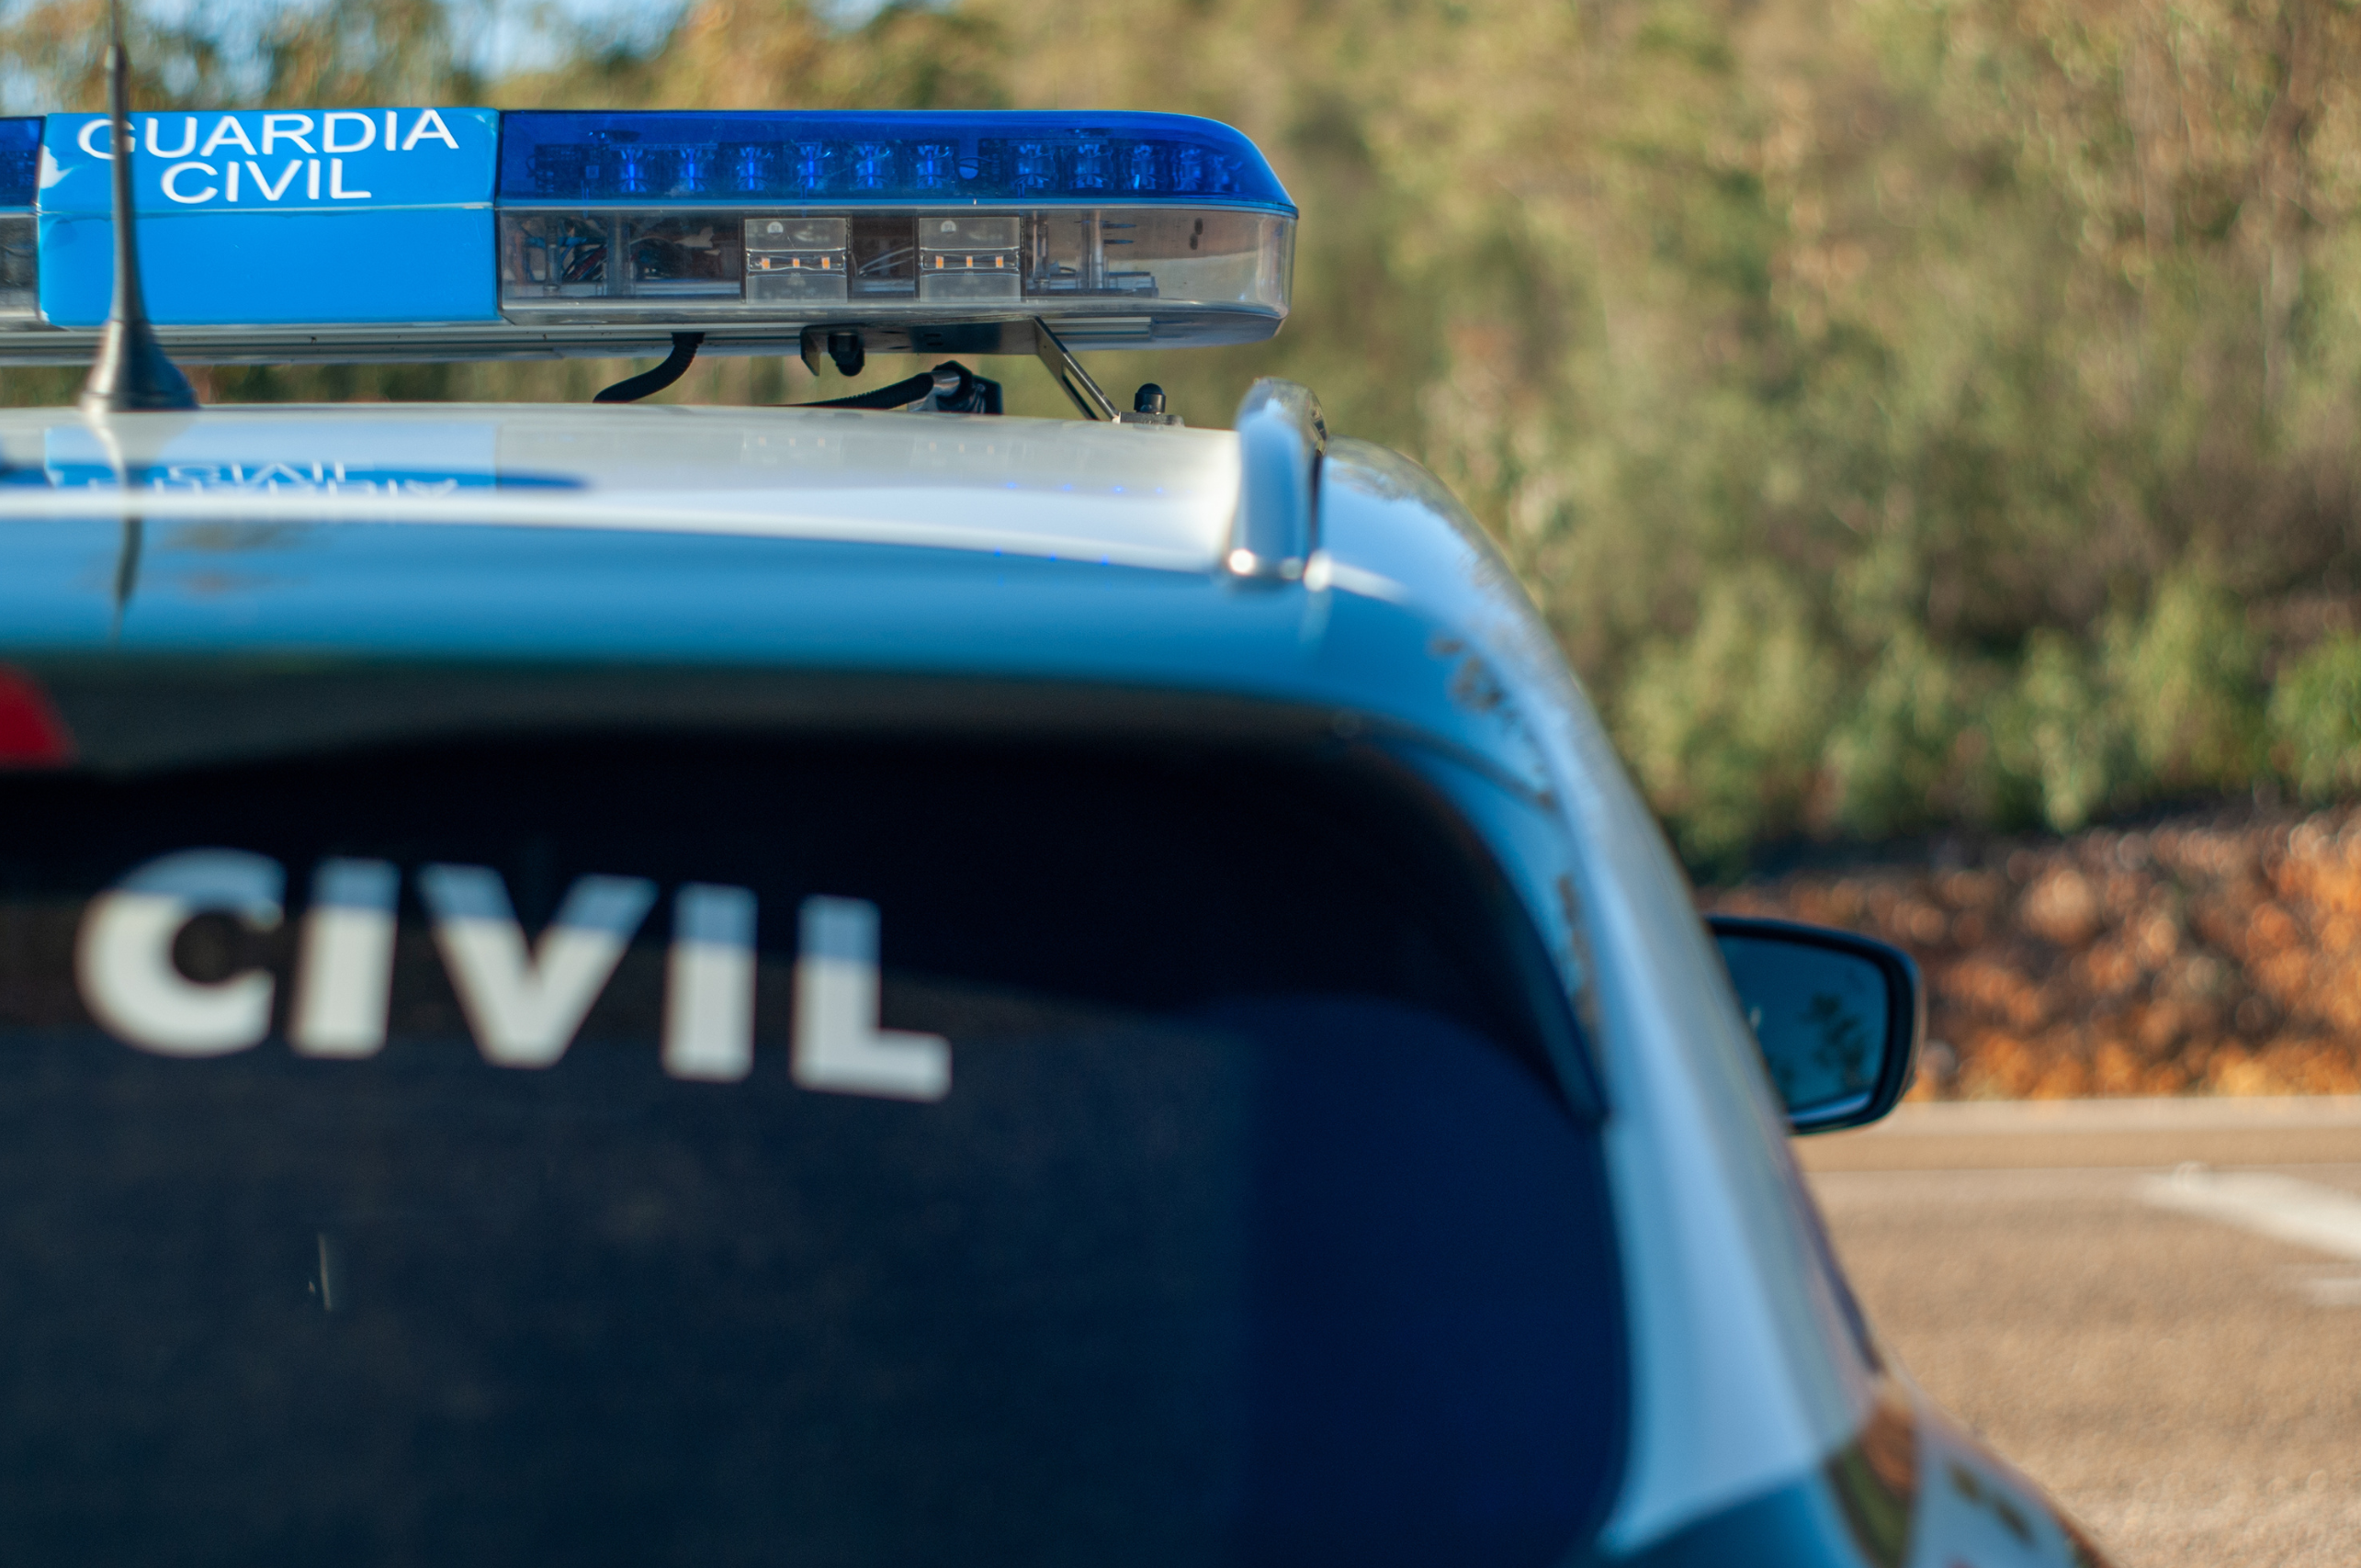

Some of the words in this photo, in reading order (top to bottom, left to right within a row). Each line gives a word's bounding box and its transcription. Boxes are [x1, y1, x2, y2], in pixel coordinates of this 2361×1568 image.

[77, 109, 459, 160] GUARDIA
[161, 158, 372, 204] CIVIL
[75, 847, 953, 1101] CIVIL
